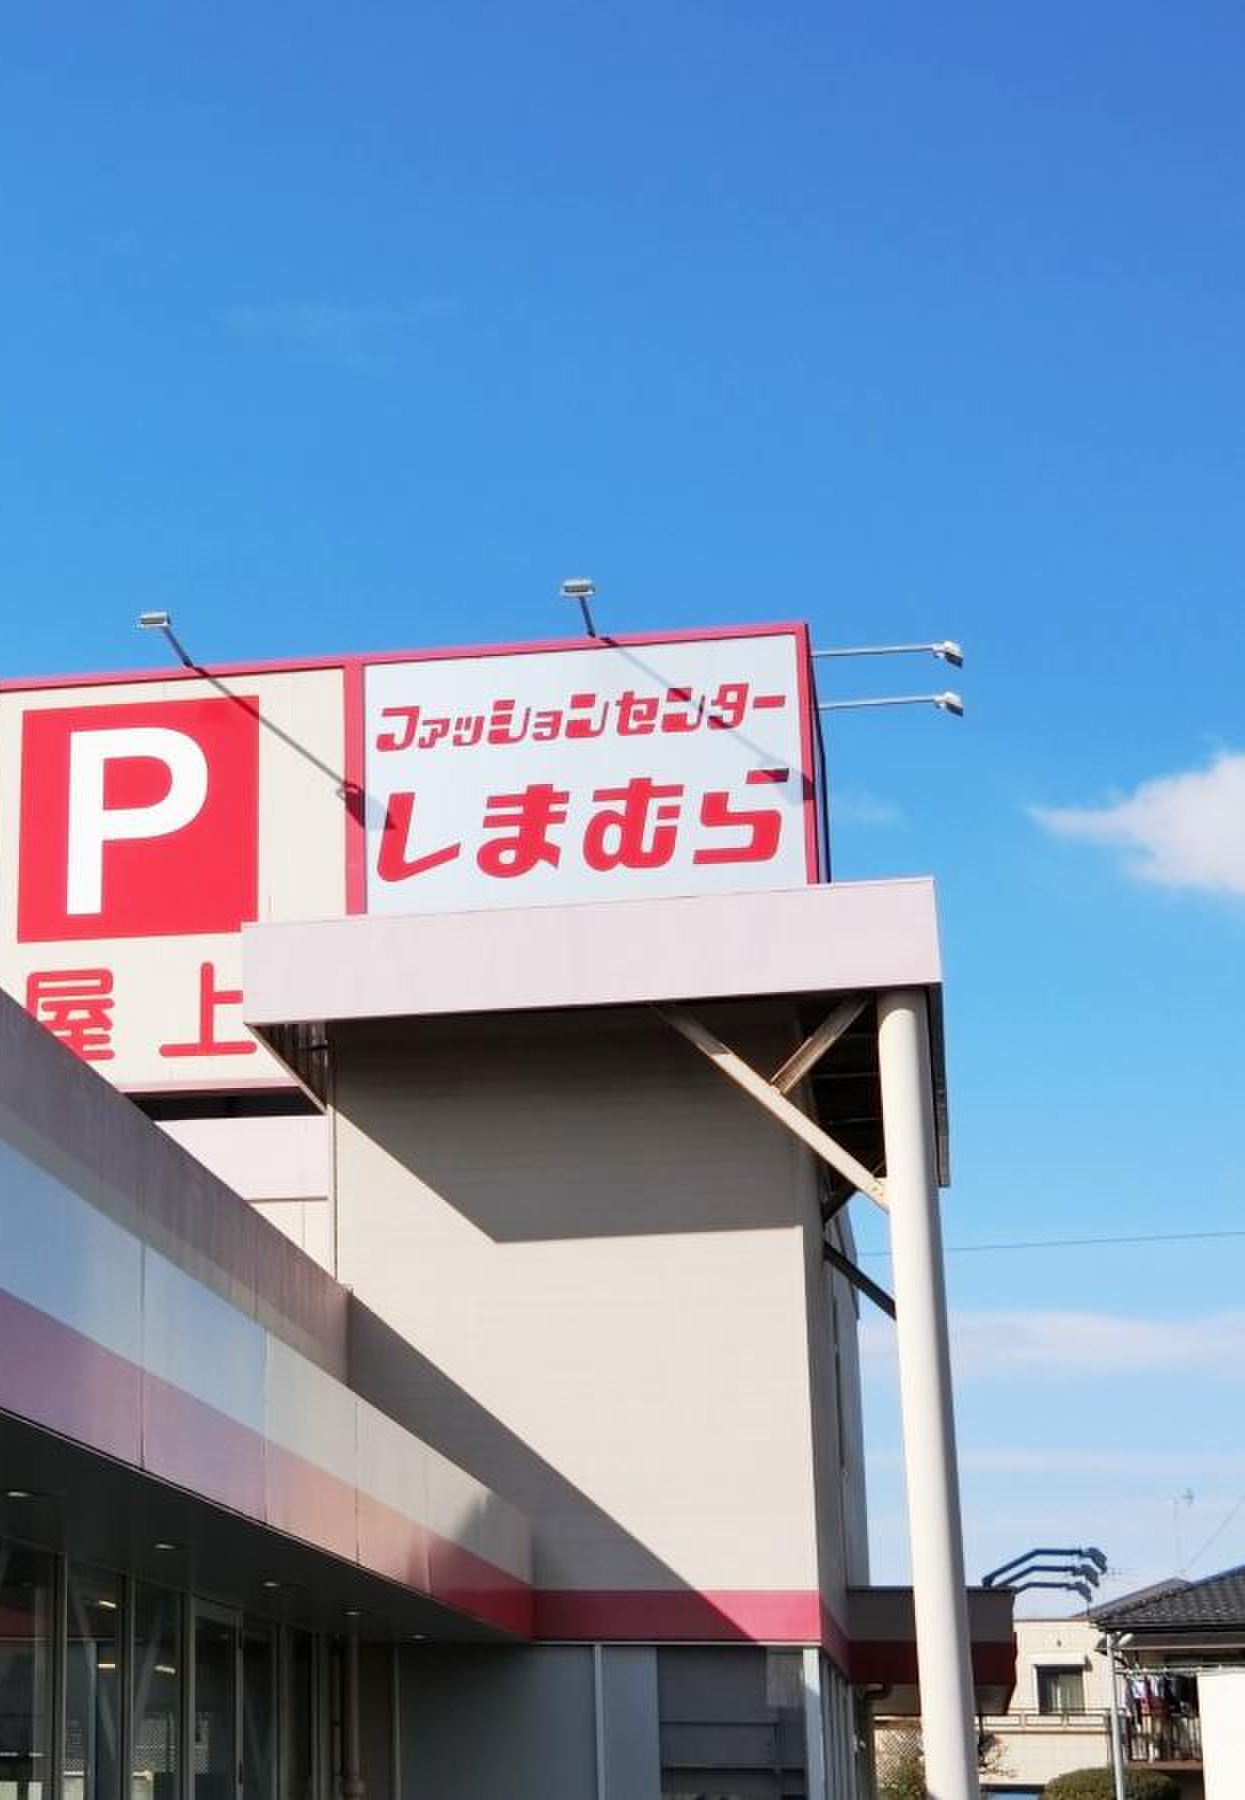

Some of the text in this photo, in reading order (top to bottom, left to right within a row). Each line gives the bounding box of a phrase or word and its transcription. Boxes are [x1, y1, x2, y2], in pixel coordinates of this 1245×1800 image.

[375, 682, 786, 753] ファッションセンター
[66, 727, 208, 915] P
[376, 767, 789, 883] しまむら
